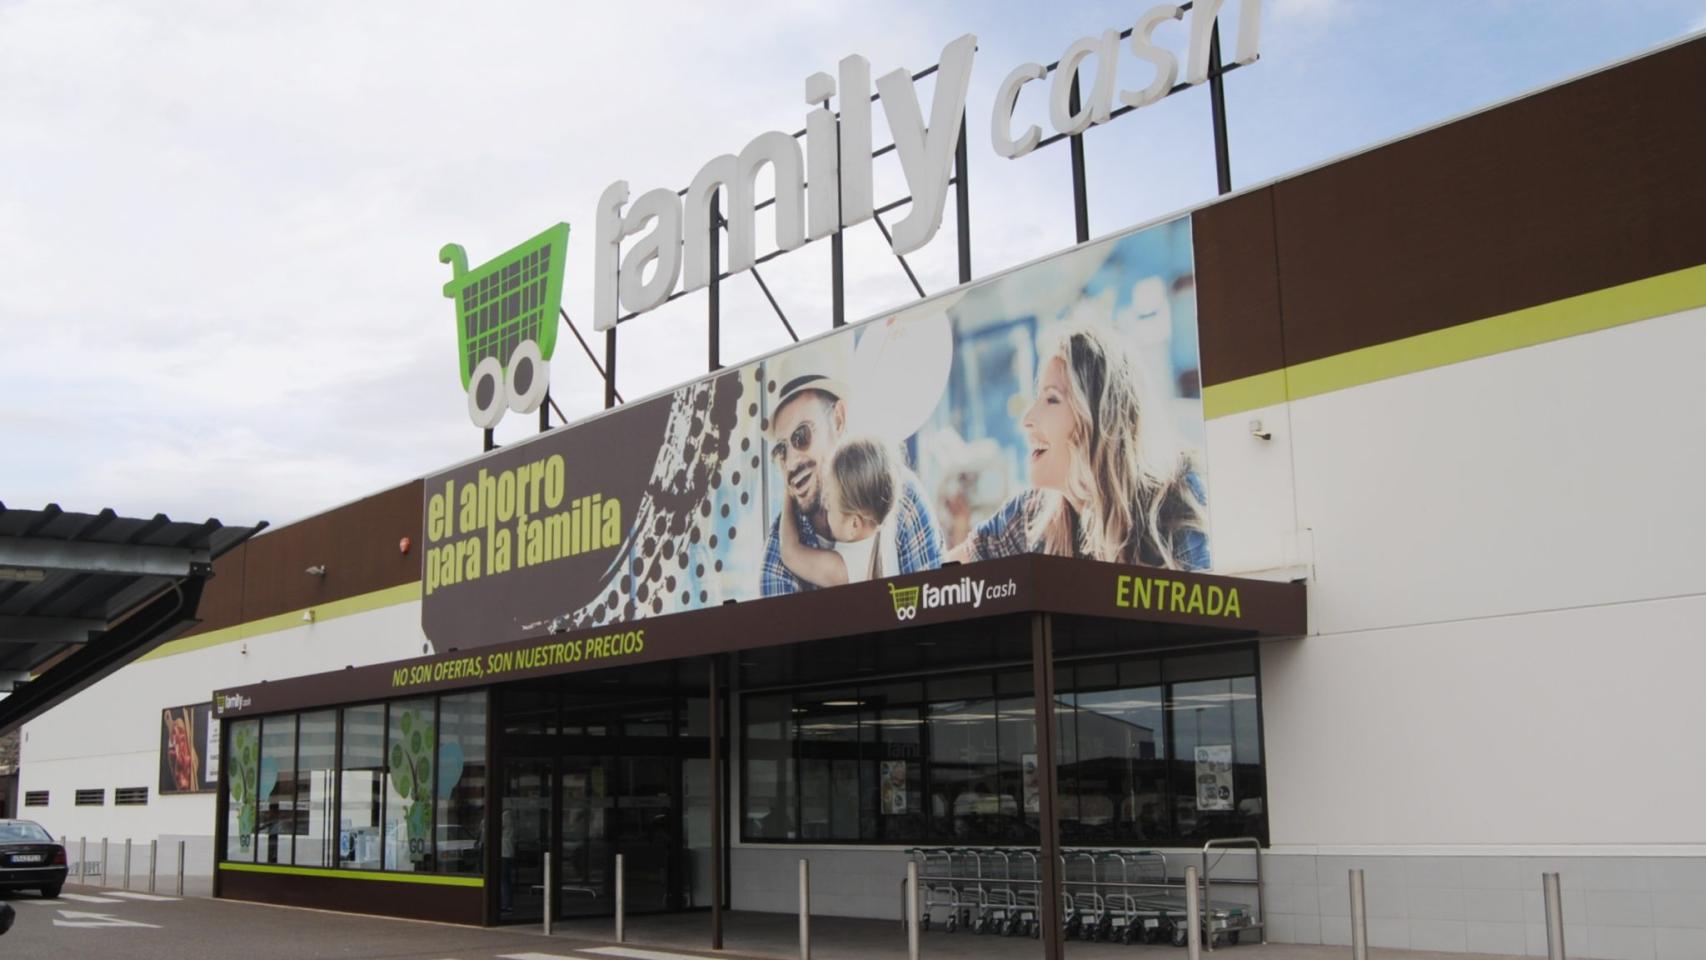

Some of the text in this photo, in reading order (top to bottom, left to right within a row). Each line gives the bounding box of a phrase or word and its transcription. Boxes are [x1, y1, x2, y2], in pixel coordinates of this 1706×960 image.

[594, 32, 978, 332] family
[428, 454, 565, 542] el ahorro
[426, 493, 621, 595] para la familia
[922, 576, 1017, 609] family cash
[1116, 575, 1241, 618] ENTRADA
[392, 630, 644, 687] NO SON OFERTAS, SON NUESTROS PRECIOS
